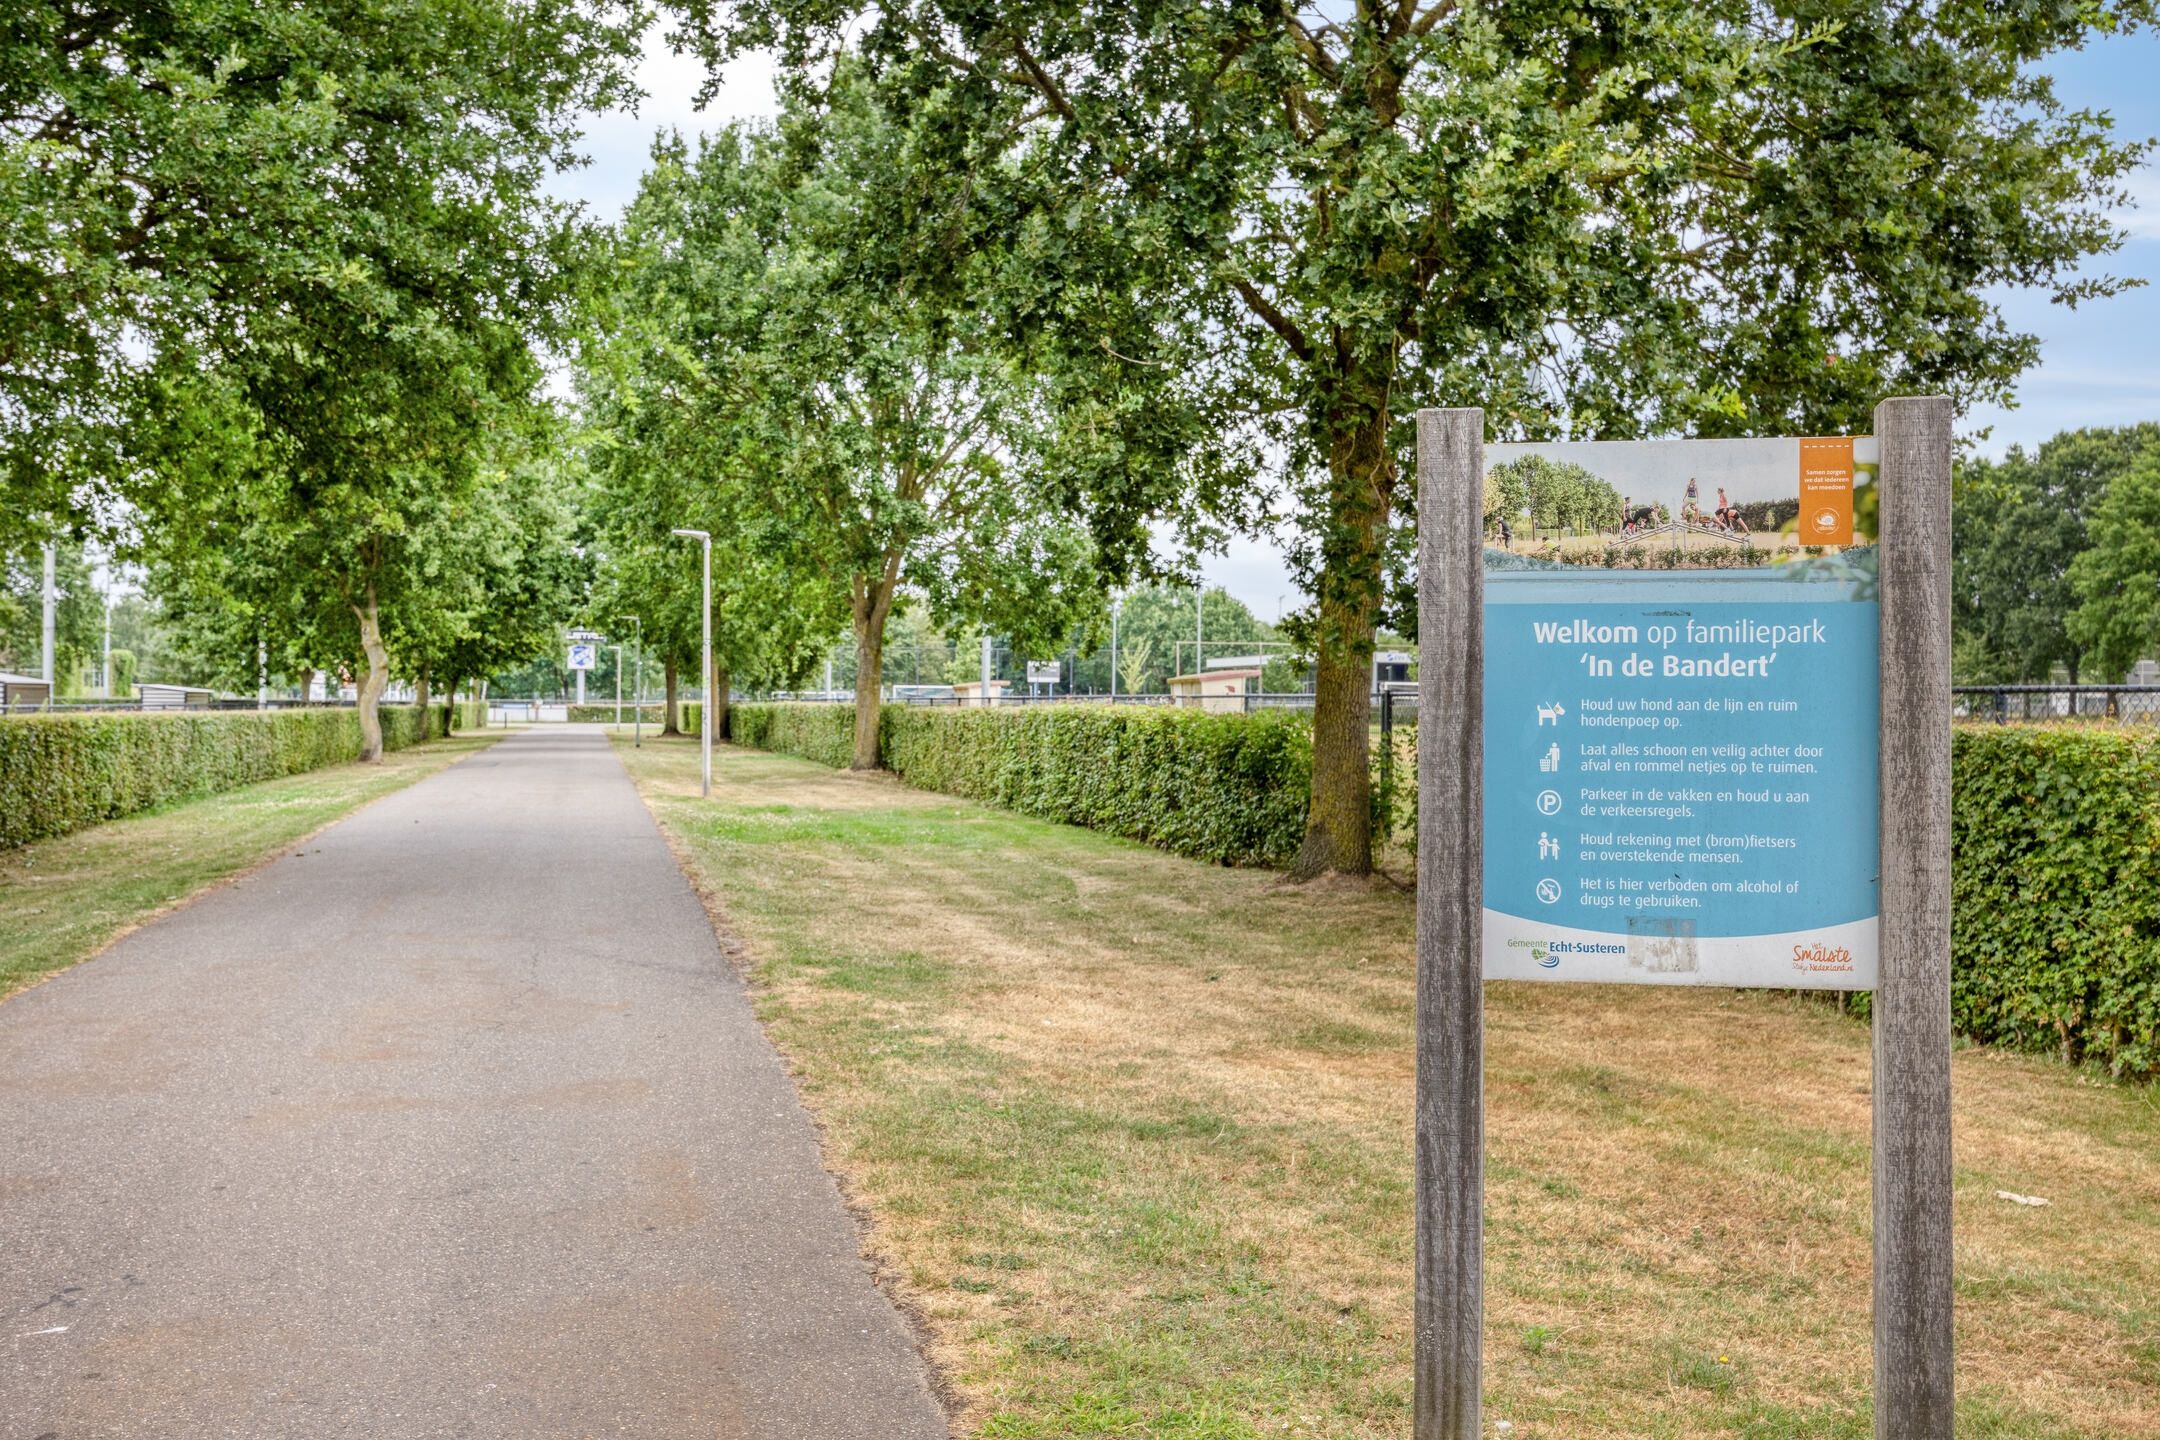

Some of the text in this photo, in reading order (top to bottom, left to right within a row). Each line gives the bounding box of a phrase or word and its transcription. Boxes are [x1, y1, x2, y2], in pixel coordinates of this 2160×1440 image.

[1532, 618, 1827, 650] Welkom op familiepark
[1621, 652, 1654, 678] de
[1581, 697, 1798, 714] Houd uw hond aan de lijn en ruim
[1580, 713, 1683, 730] hondenpoep op.
[1580, 742, 1824, 760] Laat alles schoon en veilig achter door
[1580, 758, 1818, 776] afval en rommel netjes op te ruimen.
[1543, 794, 1557, 811] P
[1580, 787, 1810, 803] Parkeer in de vakken en houd u aan
[1580, 802, 1695, 821] de verkeersregels.
[1580, 831, 1796, 850] Houd rekening met (brom)fietsers
[1579, 849, 1744, 864] en overstekende mensen.
[1580, 877, 1800, 894] Het is hier verboden om alcohol of
[1579, 892, 1702, 910] drugs te gebruiken.
[1507, 938, 1626, 954] Gemeente Echt-Susteren
[1792, 945, 1852, 962] Smalste
